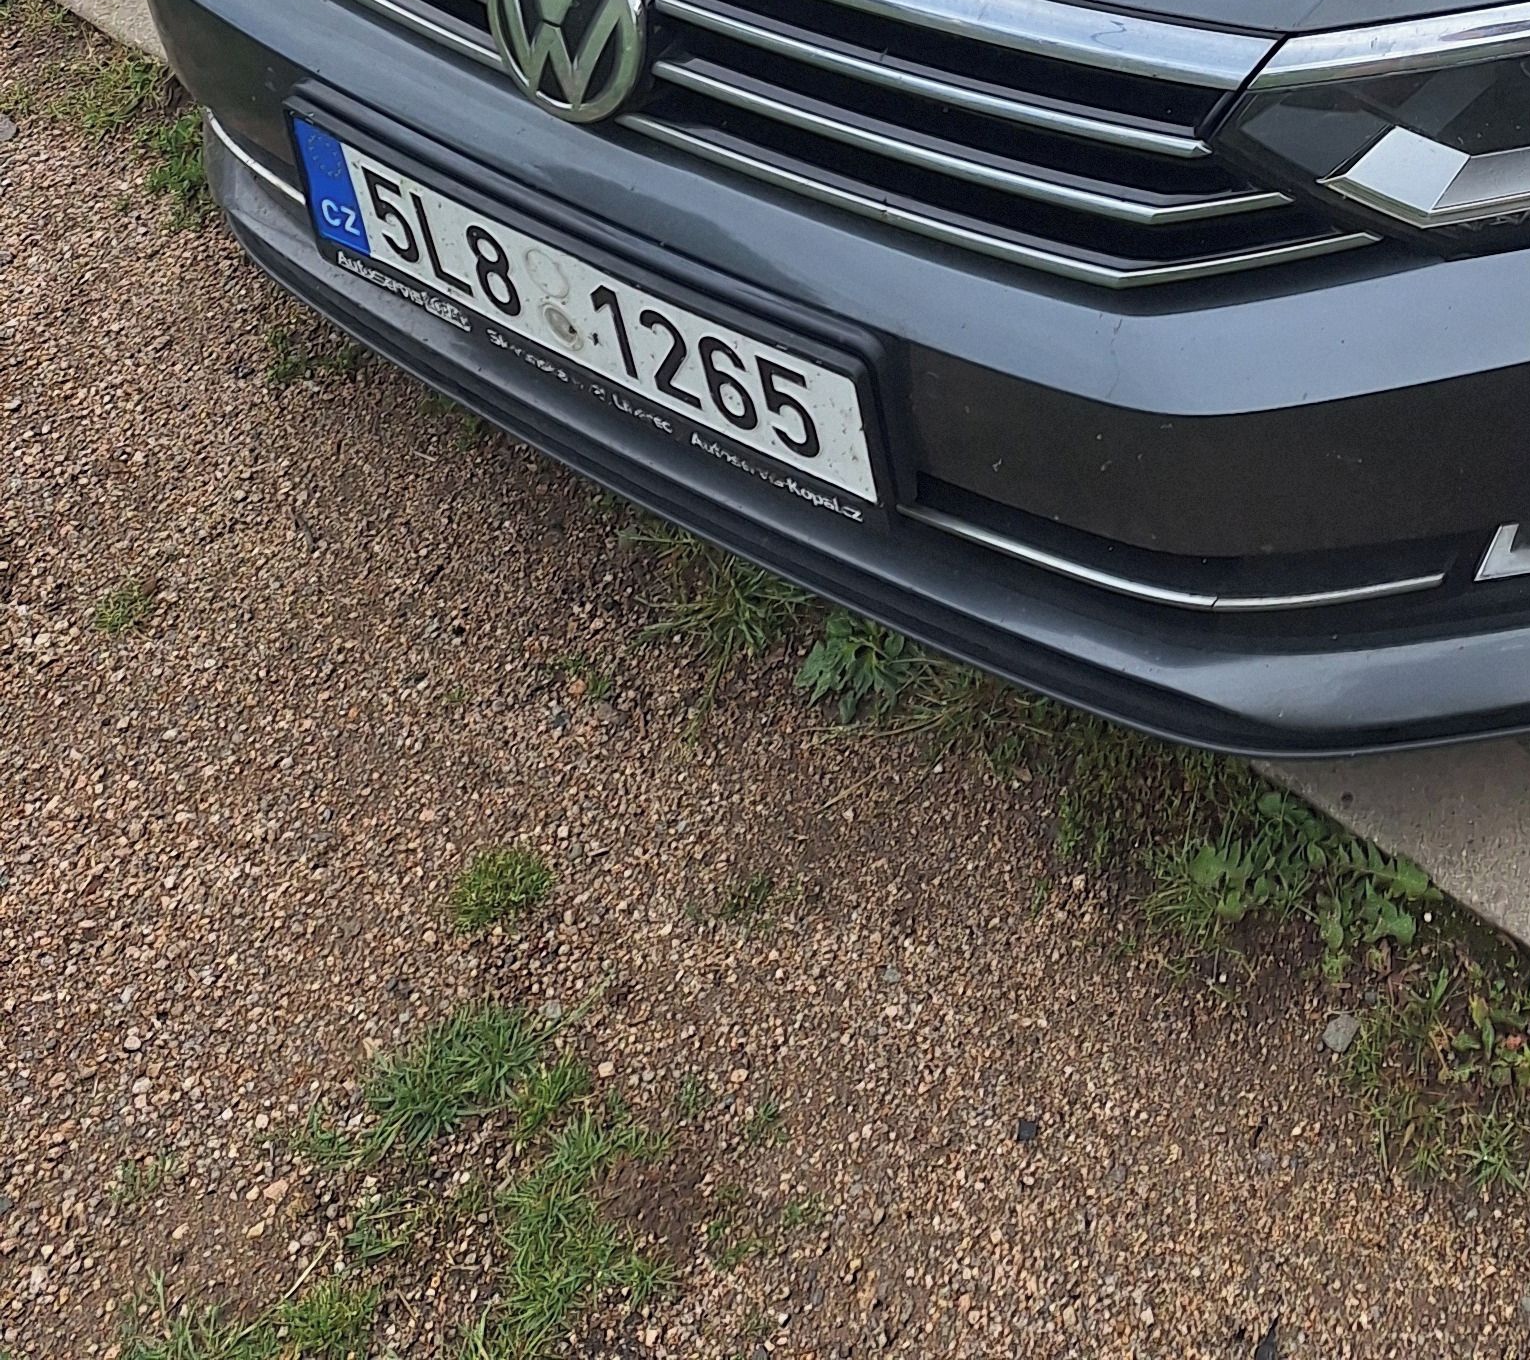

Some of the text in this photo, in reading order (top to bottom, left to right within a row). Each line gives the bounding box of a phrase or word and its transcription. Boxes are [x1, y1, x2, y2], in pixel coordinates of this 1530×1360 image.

[320, 197, 362, 238] CZ
[360, 164, 821, 459] 5L8 1265
